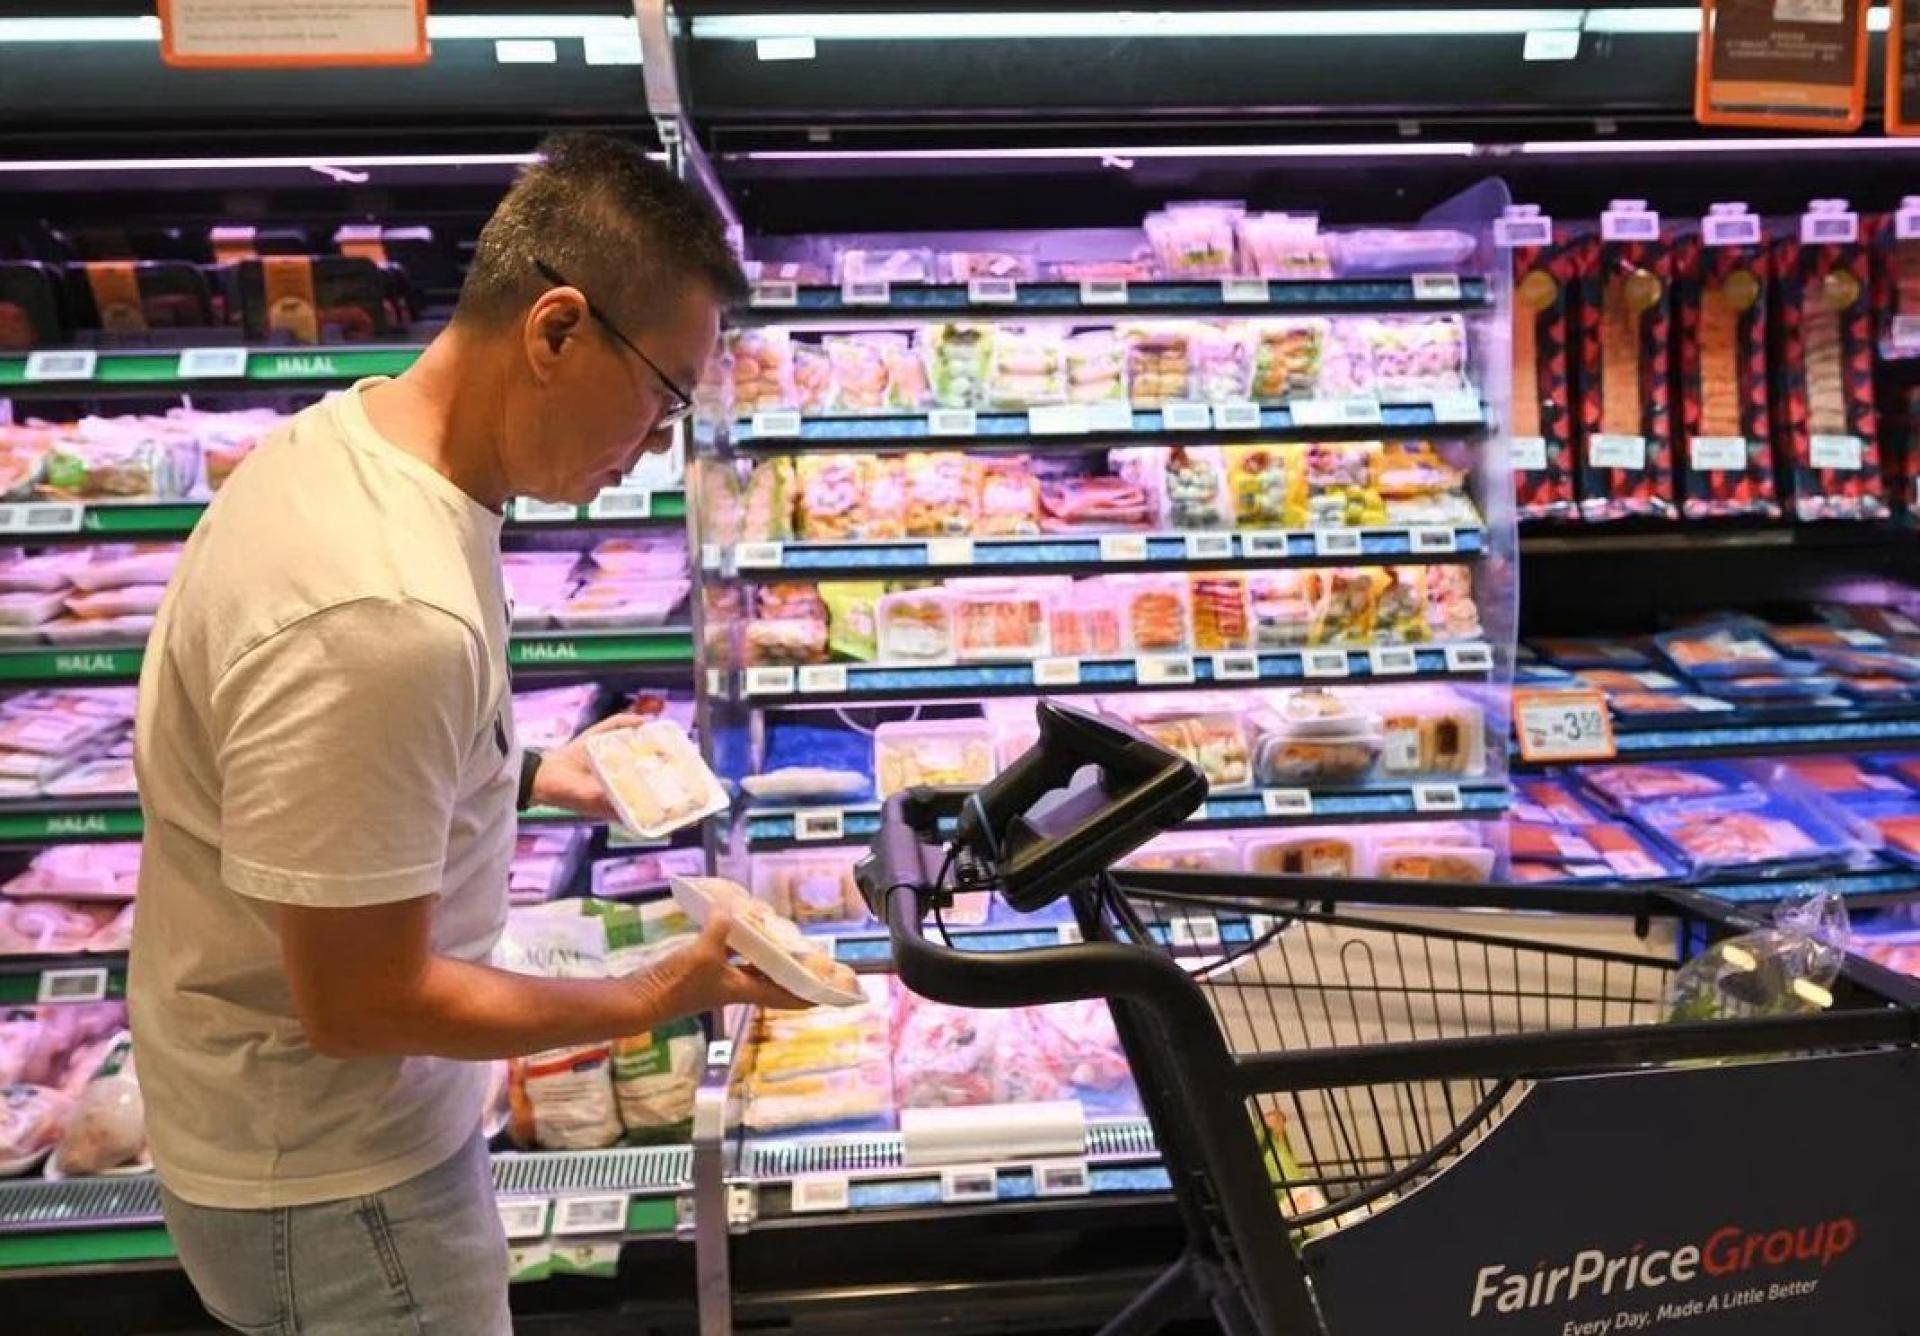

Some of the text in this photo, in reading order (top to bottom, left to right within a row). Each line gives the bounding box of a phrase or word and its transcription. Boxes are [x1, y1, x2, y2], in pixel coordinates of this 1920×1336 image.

[276, 356, 336, 375] HALAL
[520, 642, 578, 660] HALAL
[55, 654, 116, 673] HALAL
[46, 814, 108, 834] HALAL
[1562, 1318, 1611, 1336] Every
[1656, 1299, 1706, 1322] Made
[1706, 1295, 1720, 1313] A
[1723, 1287, 1765, 1309] Little
[1768, 1279, 1819, 1301] Better
